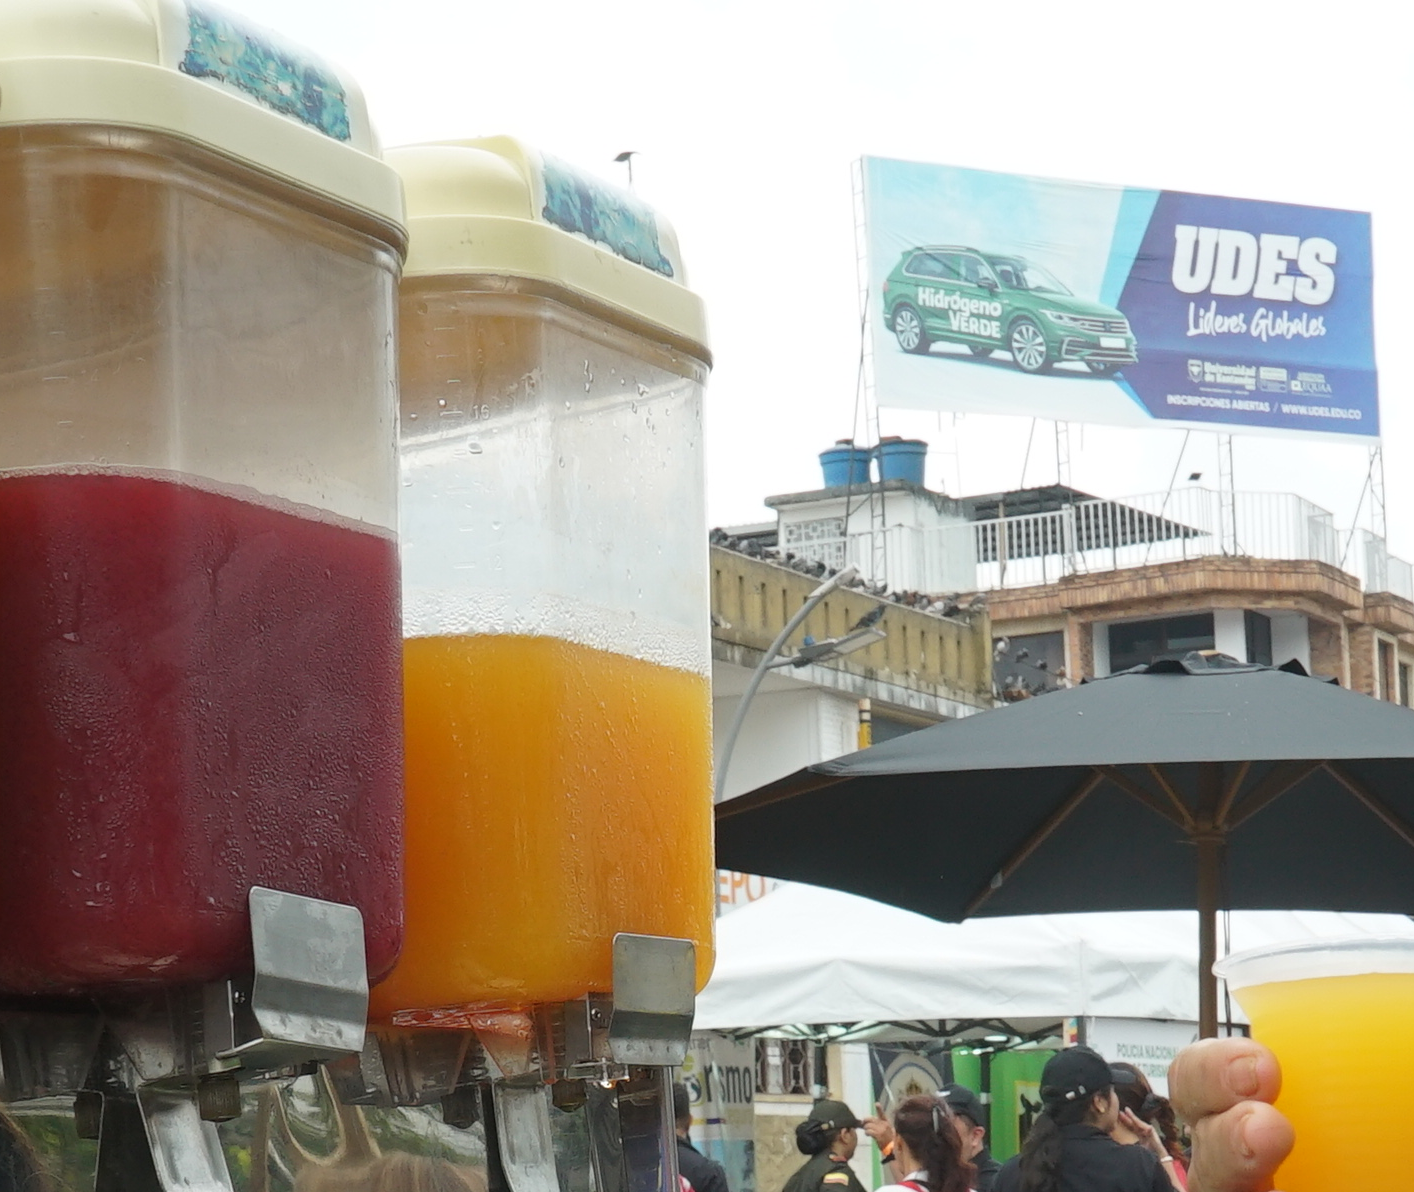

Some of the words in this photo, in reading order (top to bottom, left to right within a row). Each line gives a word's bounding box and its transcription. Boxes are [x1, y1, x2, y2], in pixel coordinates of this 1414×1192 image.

[1172, 224, 1337, 305] UDES
[918, 286, 1002, 317] Hidrógeno
[948, 310, 1001, 338] VERDE
[1250, 307, 1327, 342] Globales
[1166, 394, 1230, 409] INSCRIPCIONES
[1232, 400, 1270, 413] ABIERTAS
